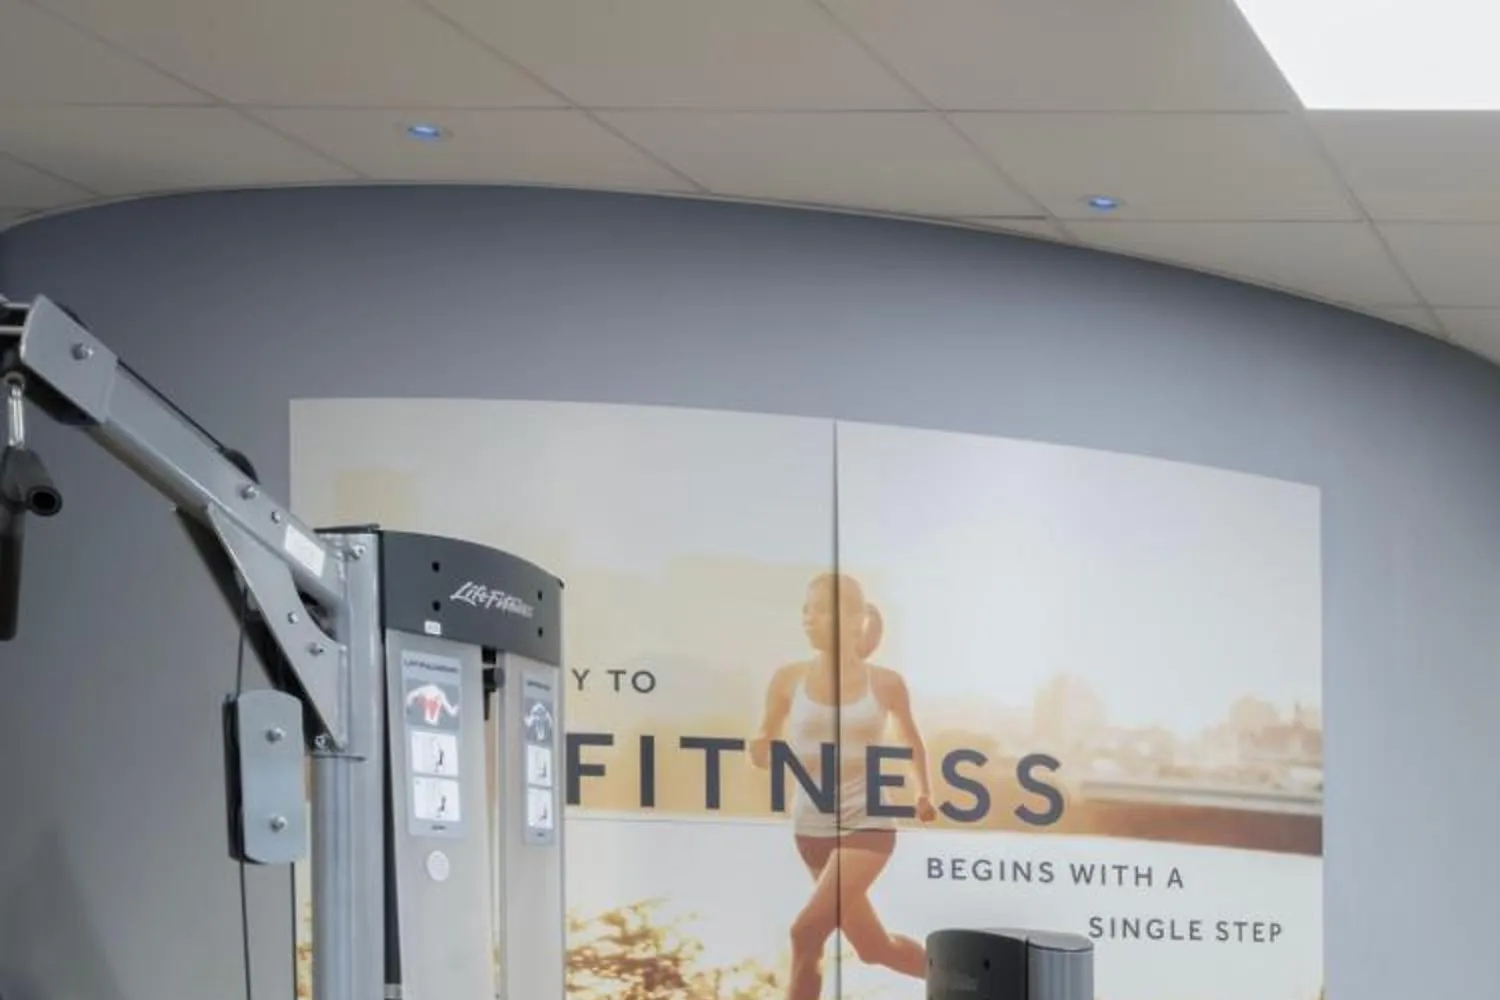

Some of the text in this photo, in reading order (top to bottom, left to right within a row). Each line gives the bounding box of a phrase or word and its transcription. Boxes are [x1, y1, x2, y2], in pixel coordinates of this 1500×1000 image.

[607, 669, 656, 694] TO
[566, 733, 1065, 826] FITNESS
[926, 857, 1184, 889] BEGINS WITH A
[1088, 916, 1283, 943] SINGLE STEP
